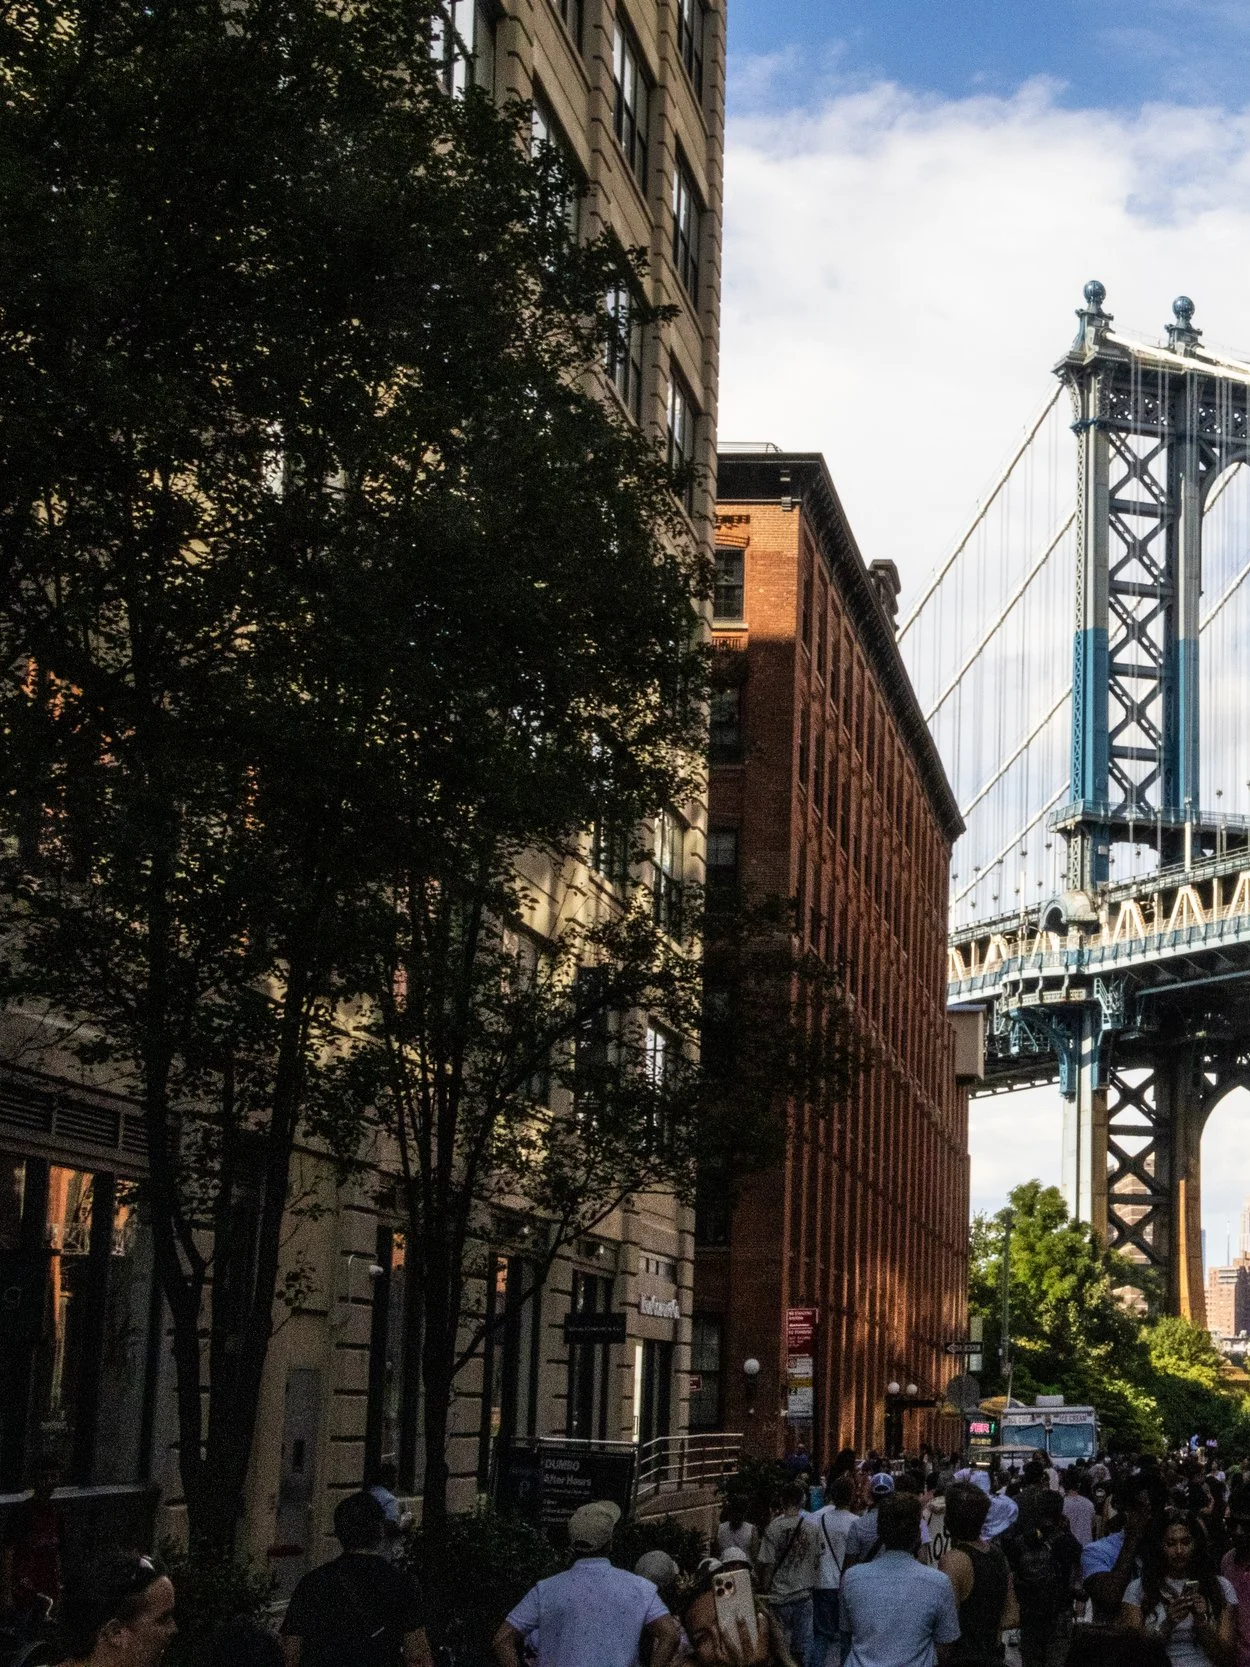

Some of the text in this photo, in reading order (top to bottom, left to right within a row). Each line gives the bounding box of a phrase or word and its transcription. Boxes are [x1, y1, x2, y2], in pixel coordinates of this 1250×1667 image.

[544, 1458, 580, 1472] DUMBO
[543, 1473, 592, 1486] After Hours
